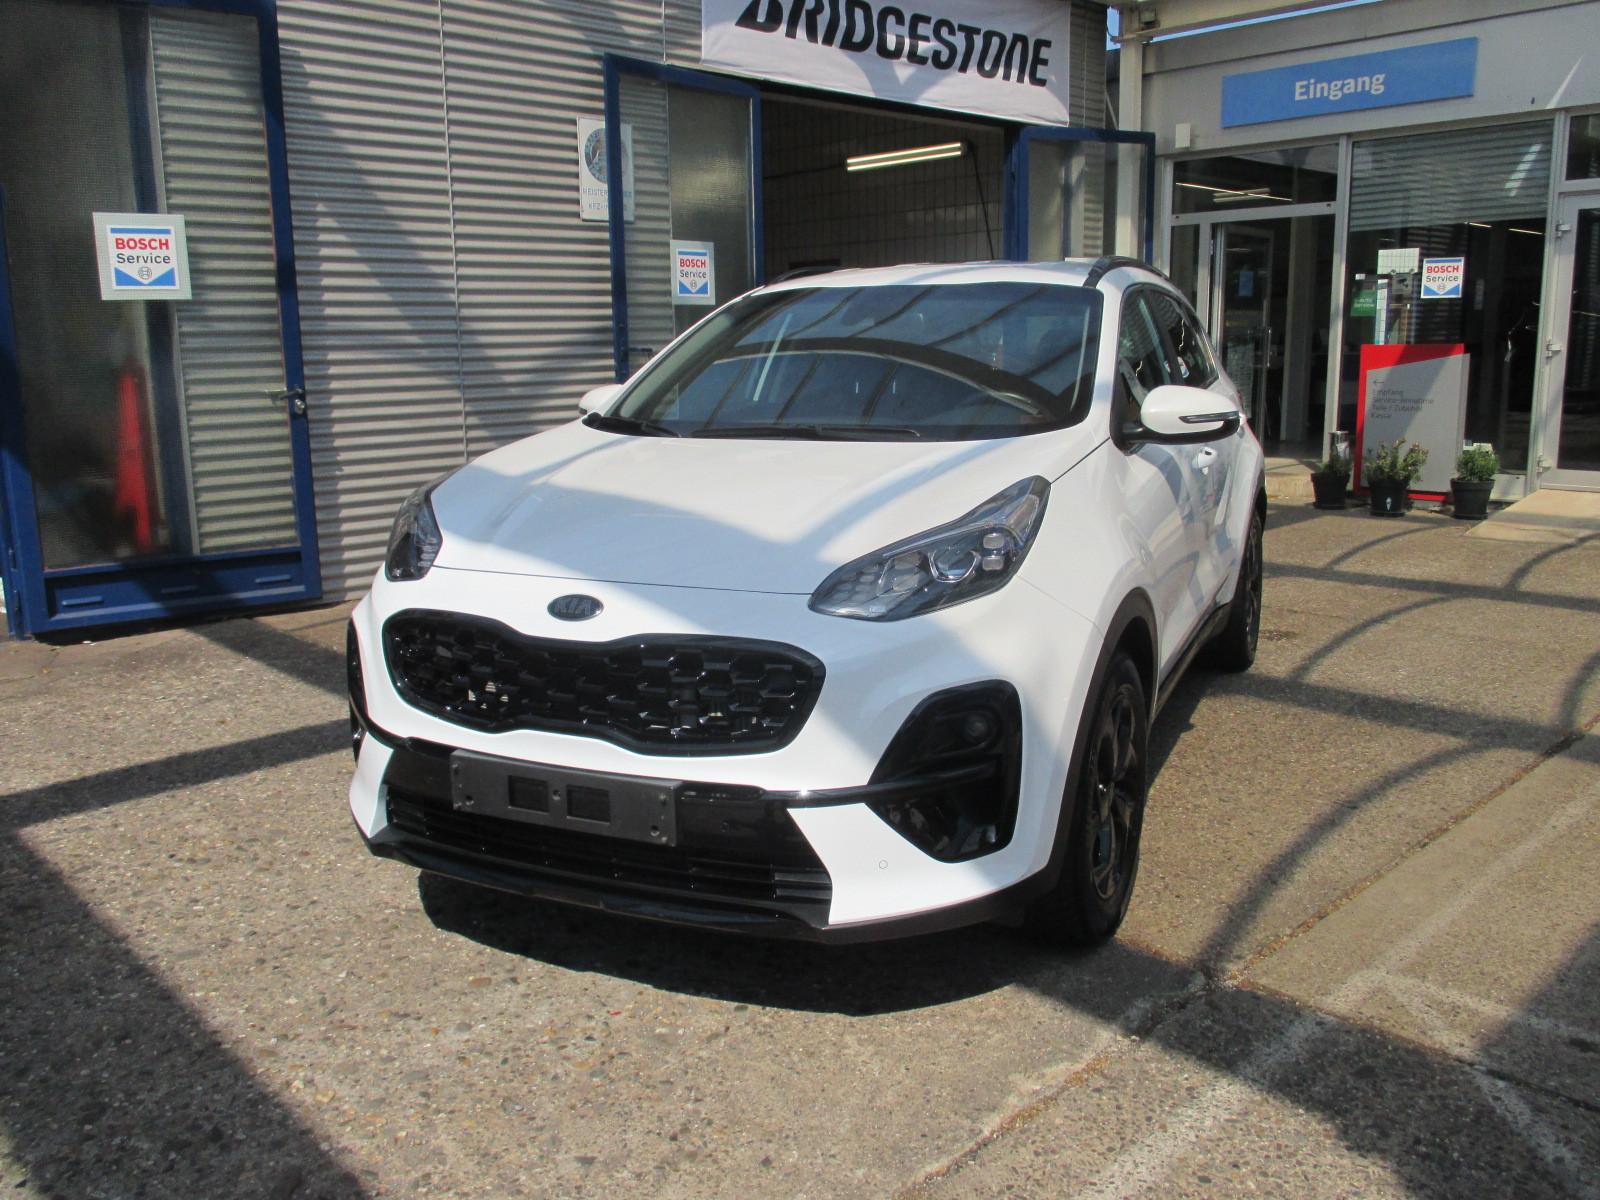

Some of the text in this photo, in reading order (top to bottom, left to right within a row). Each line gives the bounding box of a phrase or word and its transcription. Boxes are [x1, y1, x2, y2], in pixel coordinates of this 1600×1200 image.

[735, 0, 1052, 87] BRIDGESTONE
[1294, 73, 1386, 101] Eingang
[115, 237, 170, 251] BOSCH
[116, 252, 171, 265] Service
[680, 258, 707, 269] BOSCH
[680, 269, 707, 279] Service
[1426, 265, 1460, 274] BOSCH
[1426, 274, 1459, 283] Service
[554, 597, 592, 617] KIA
